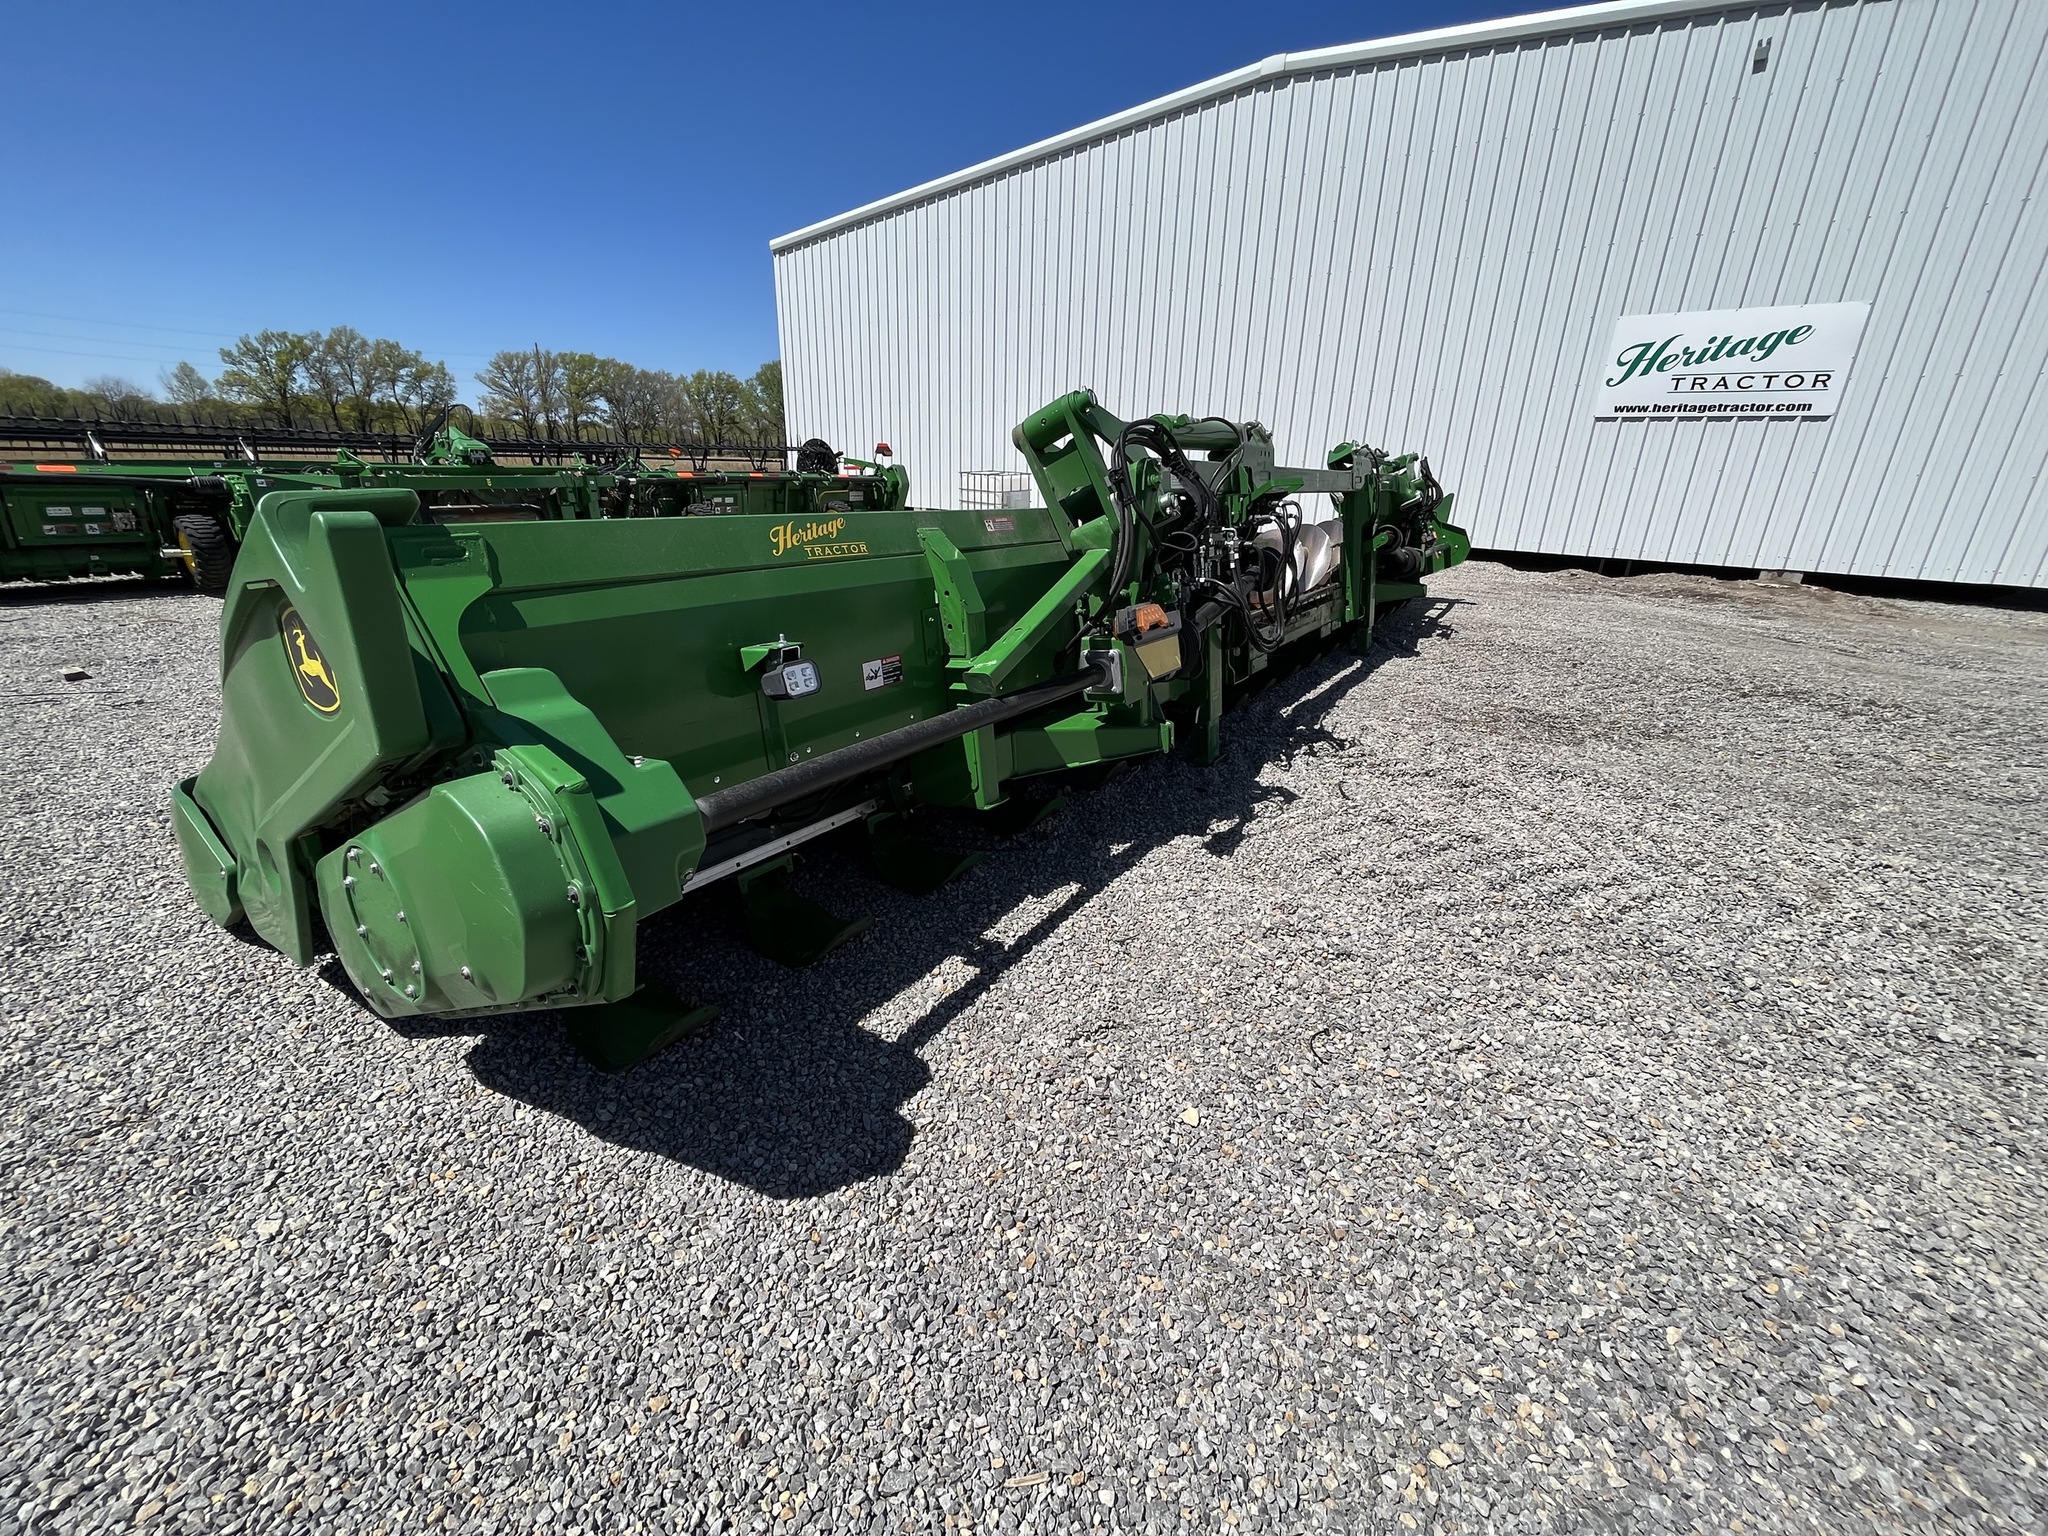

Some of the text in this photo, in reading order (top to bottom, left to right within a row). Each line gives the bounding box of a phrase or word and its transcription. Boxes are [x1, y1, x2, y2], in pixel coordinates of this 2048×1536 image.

[1606, 324, 1816, 387] Heritage
[1671, 374, 1832, 391] TRACTOR
[1614, 402, 1813, 414] www.heritagetractor.com
[769, 517, 846, 556] Heritage
[804, 544, 868, 557] TRACTOR
